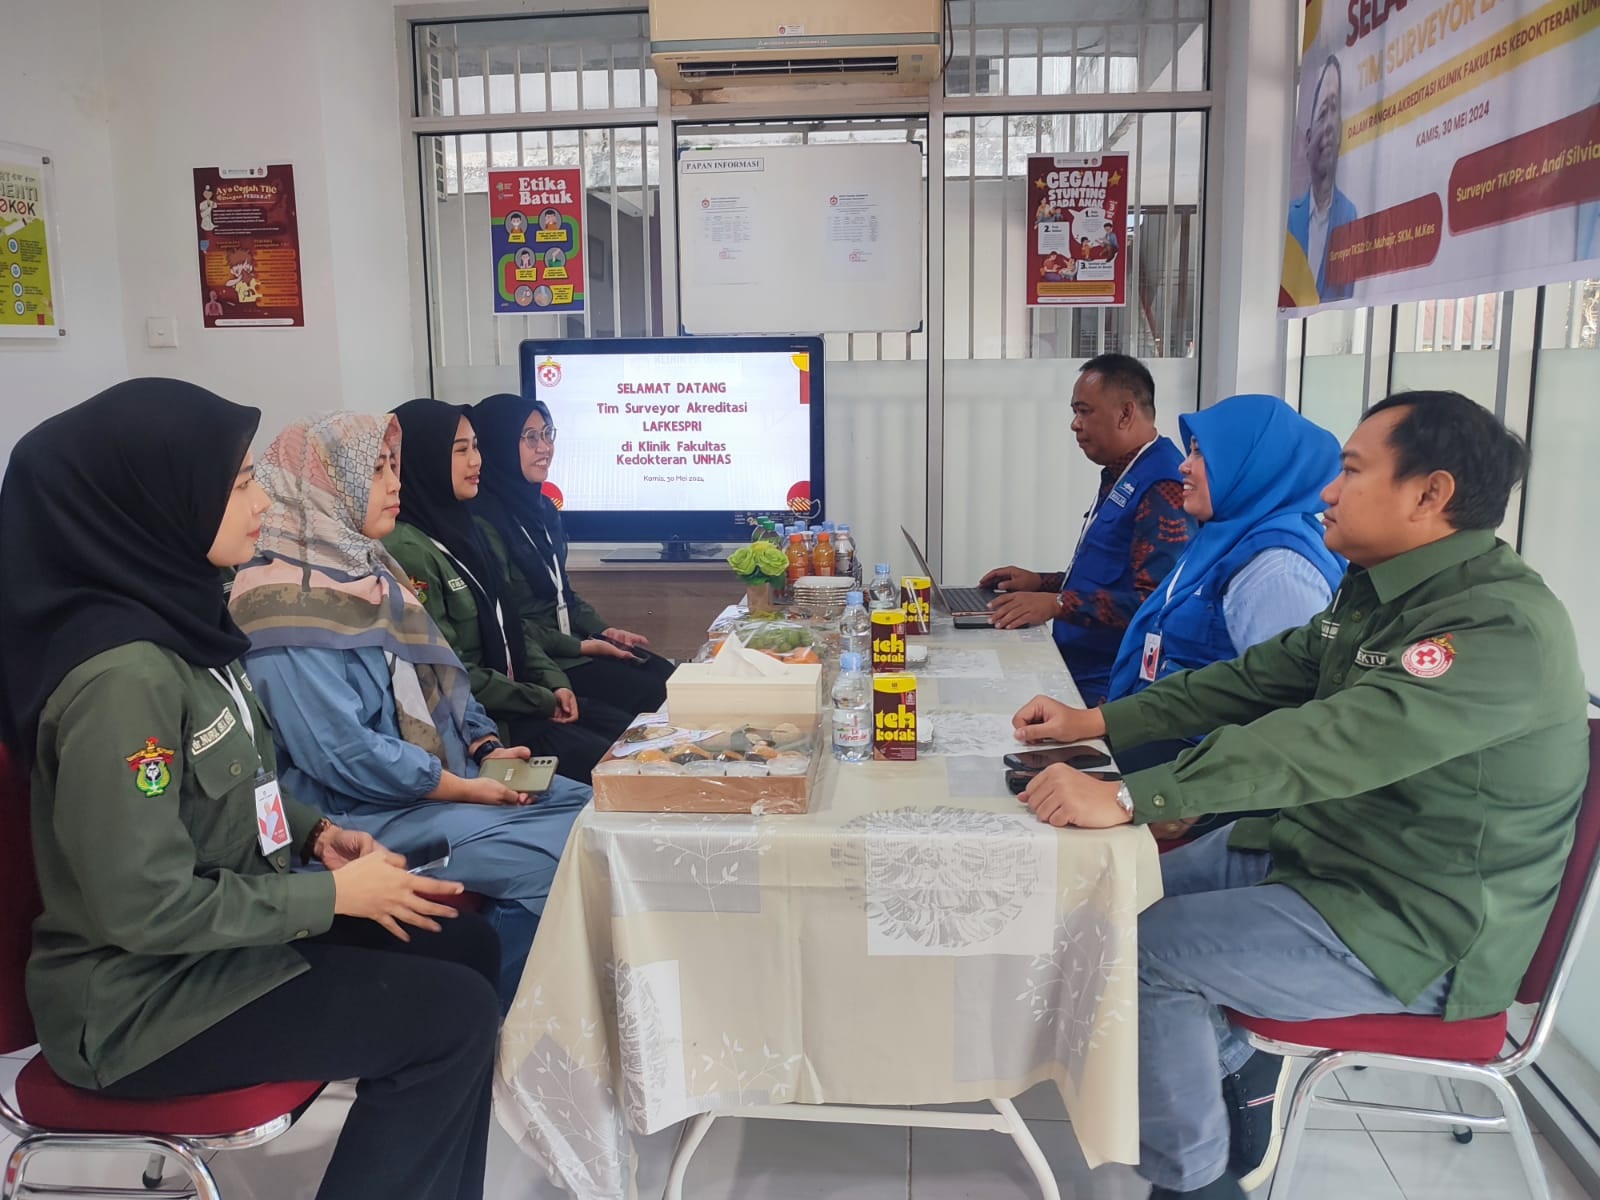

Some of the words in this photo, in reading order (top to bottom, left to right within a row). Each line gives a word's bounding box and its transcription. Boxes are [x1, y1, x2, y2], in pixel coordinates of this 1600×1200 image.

[1357, 49, 1384, 92] TIM
[1387, 0, 1475, 74] SURVEYOR
[1347, 118, 1369, 138] DALAM
[1369, 103, 1396, 128] RANGKA
[1398, 80, 1437, 113] AKREDITASI
[1437, 66, 1463, 92] KLINIK
[1463, 41, 1507, 78] FAKULTAS
[1508, 2, 1580, 53] KEDOKTERAN
[1416, 125, 1440, 148] KAMIS,
[1442, 117, 1453, 135] 30
[1453, 110, 1467, 131] MEI
[1468, 99, 1490, 123] 2024
[686, 161, 712, 170] PAPAN
[714, 160, 760, 169] INFORMASI
[1456, 178, 1496, 202] Surveyor
[1497, 167, 1525, 190] TKPP:
[1525, 162, 1539, 180] dr.
[1541, 150, 1566, 176] Andi
[1566, 140, 1600, 166] Silvia
[518, 177, 567, 192] Etika
[1047, 171, 1108, 189] CEGAH
[519, 190, 573, 205] Batuk
[1048, 188, 1106, 200] STUNTING
[617, 383, 671, 394] SELAMAT
[677, 382, 727, 394] DATANG
[597, 402, 619, 414] Tim
[625, 402, 680, 416] Surveyor
[686, 401, 748, 413] Akreditasi
[642, 420, 702, 432] LAFKESPRI
[621, 441, 633, 452] di
[638, 441, 671, 452] Klinik
[677, 440, 727, 452] Fakultas
[616, 454, 687, 465] Kedokteran
[693, 453, 732, 465] UNHAS
[902, 597, 929, 614] teh
[873, 633, 904, 653] teh
[873, 653, 904, 663] kotak
[875, 704, 915, 729] teh
[875, 728, 915, 742] kotak
